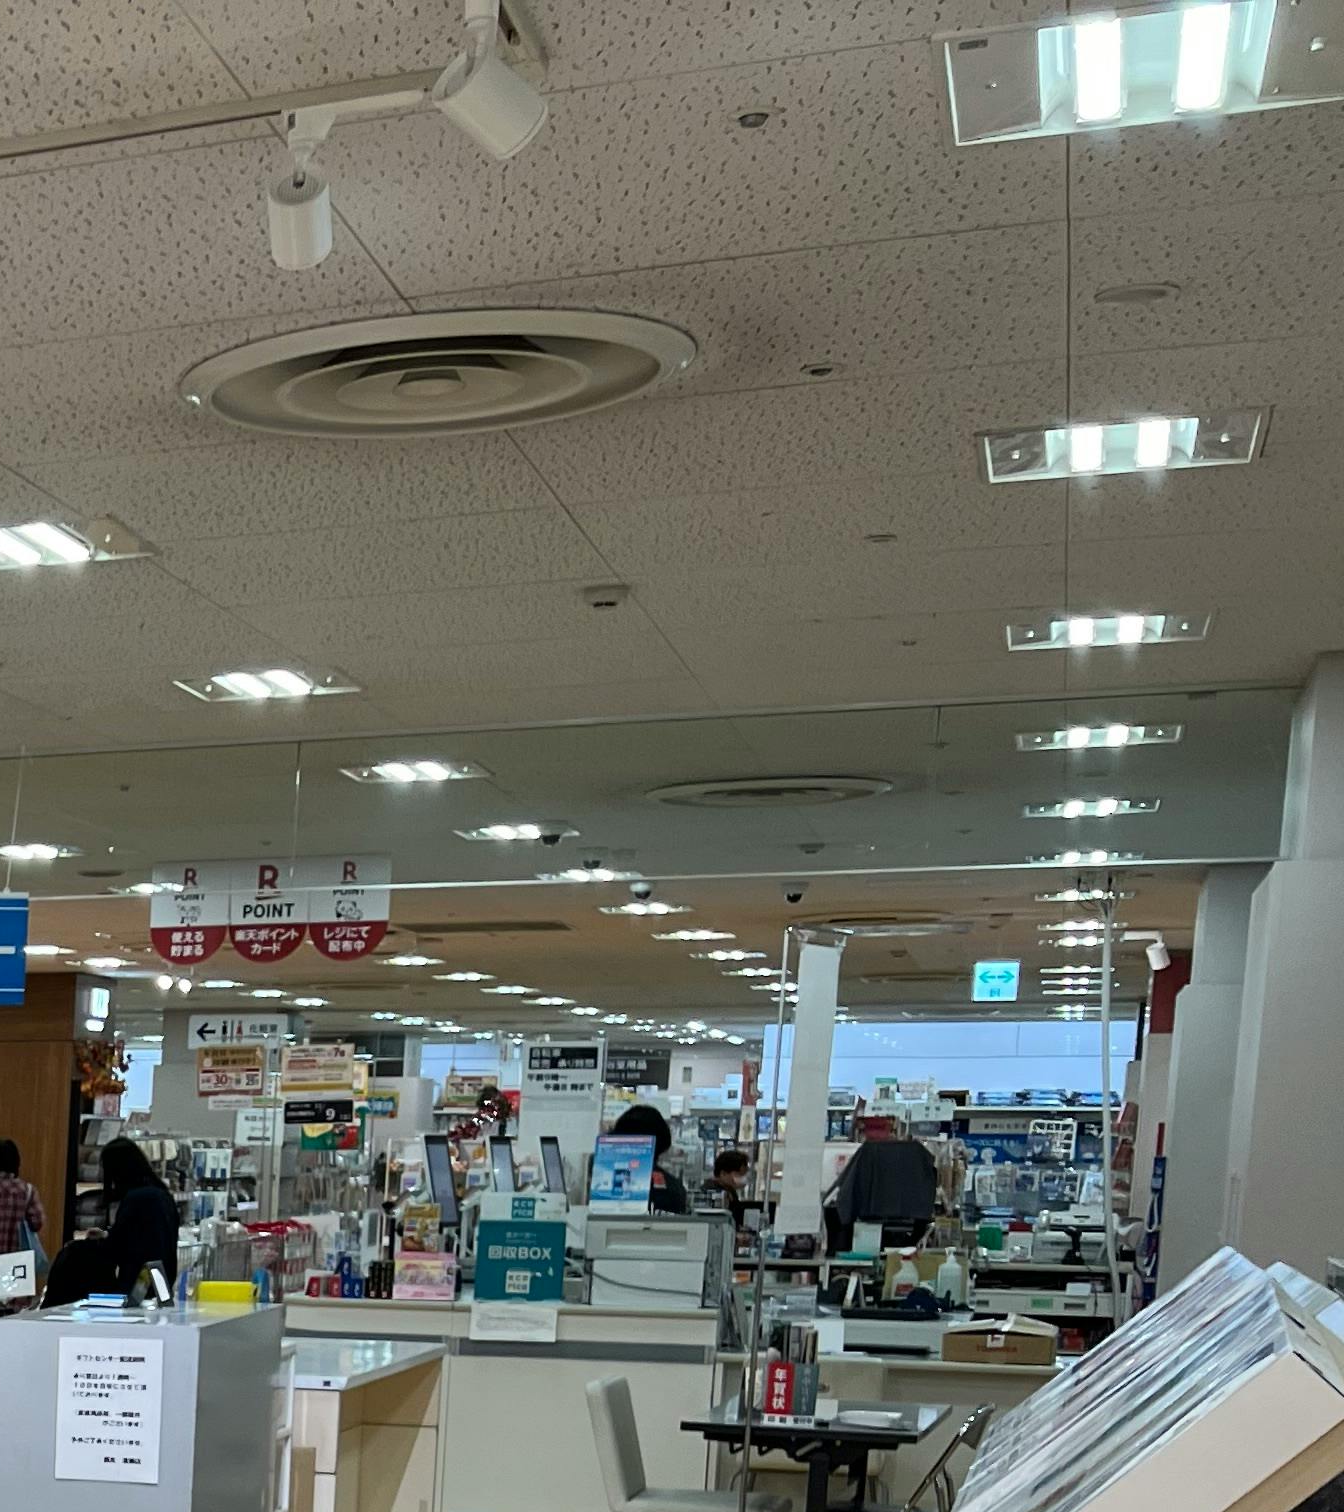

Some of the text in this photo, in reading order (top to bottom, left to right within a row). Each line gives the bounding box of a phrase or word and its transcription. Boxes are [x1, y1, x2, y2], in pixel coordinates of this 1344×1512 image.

[242, 903, 295, 919] POINT
[251, 943, 282, 955] カード
[488, 1245, 552, 1260] 回収BOX
[772, 1368, 787, 1410] 年賀状
